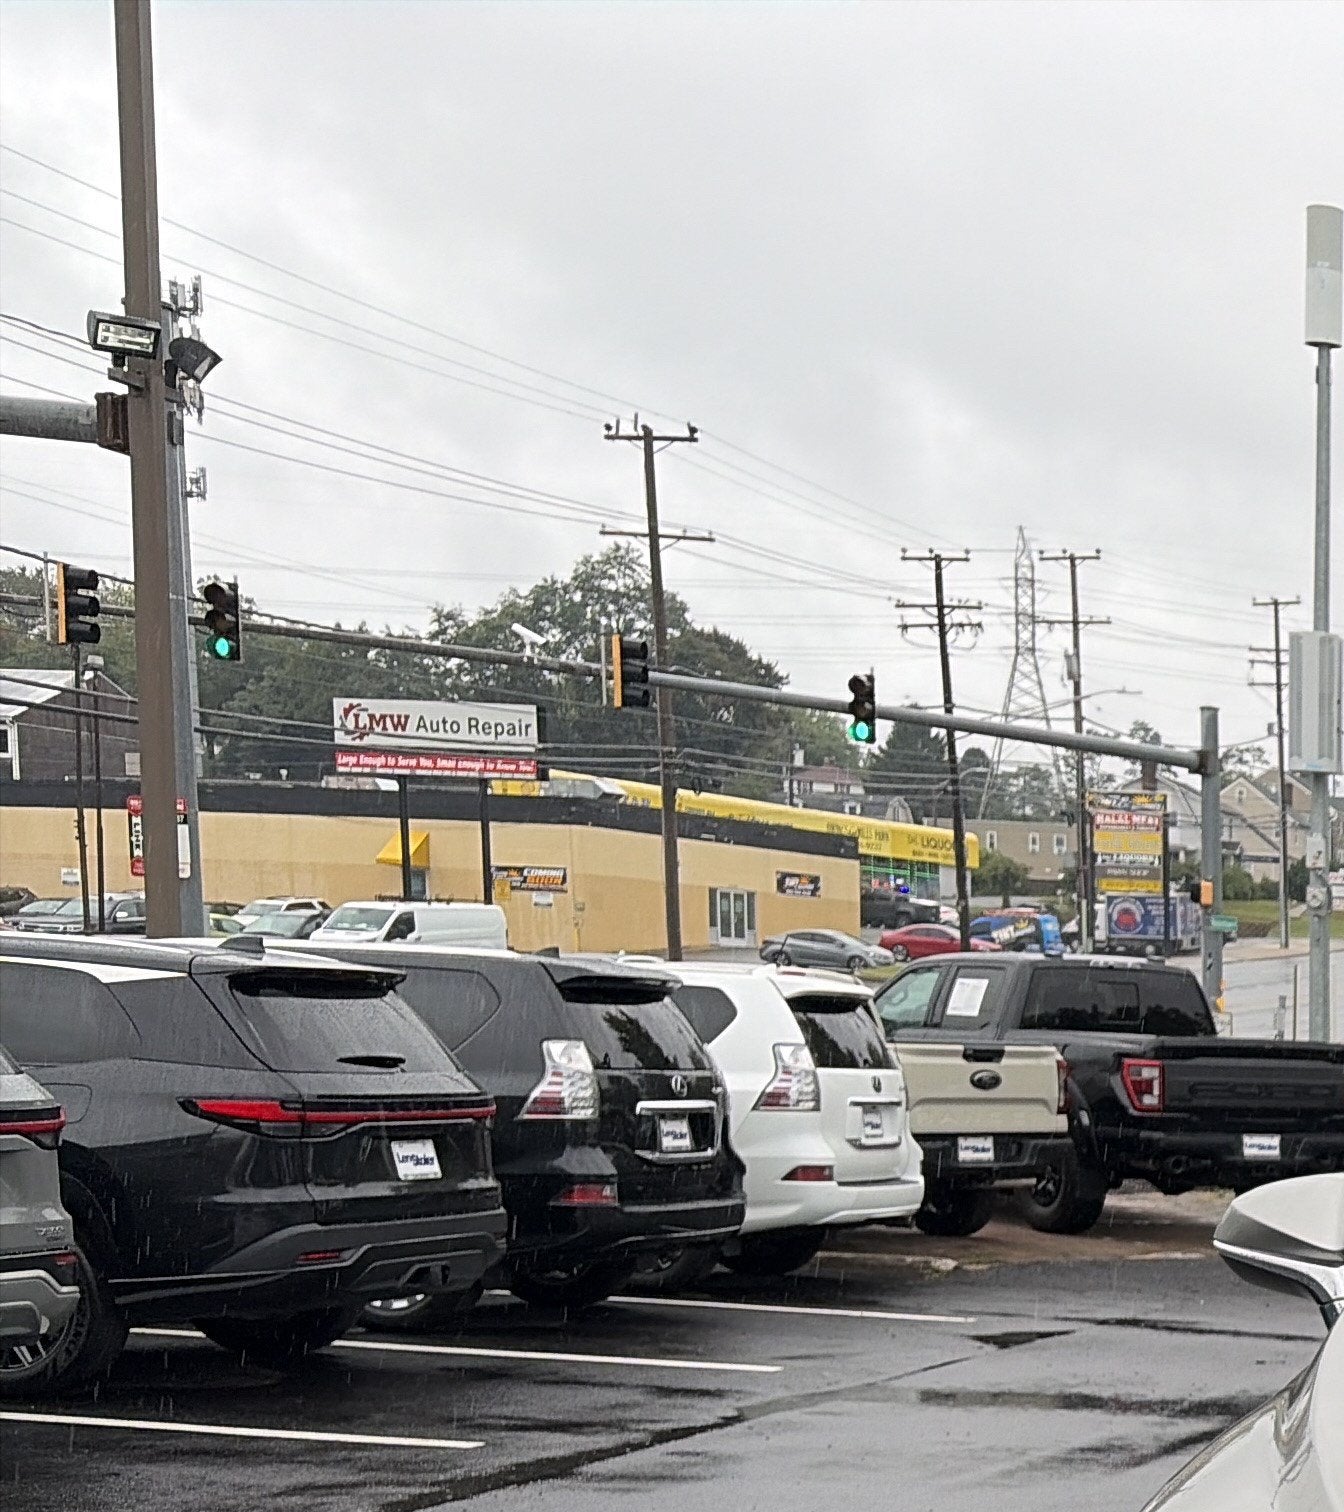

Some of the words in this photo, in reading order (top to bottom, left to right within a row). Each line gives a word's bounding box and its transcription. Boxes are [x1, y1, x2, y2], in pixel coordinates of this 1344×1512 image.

[353, 712, 410, 732] LMW
[416, 715, 461, 734] Auto
[467, 717, 532, 740] Repair
